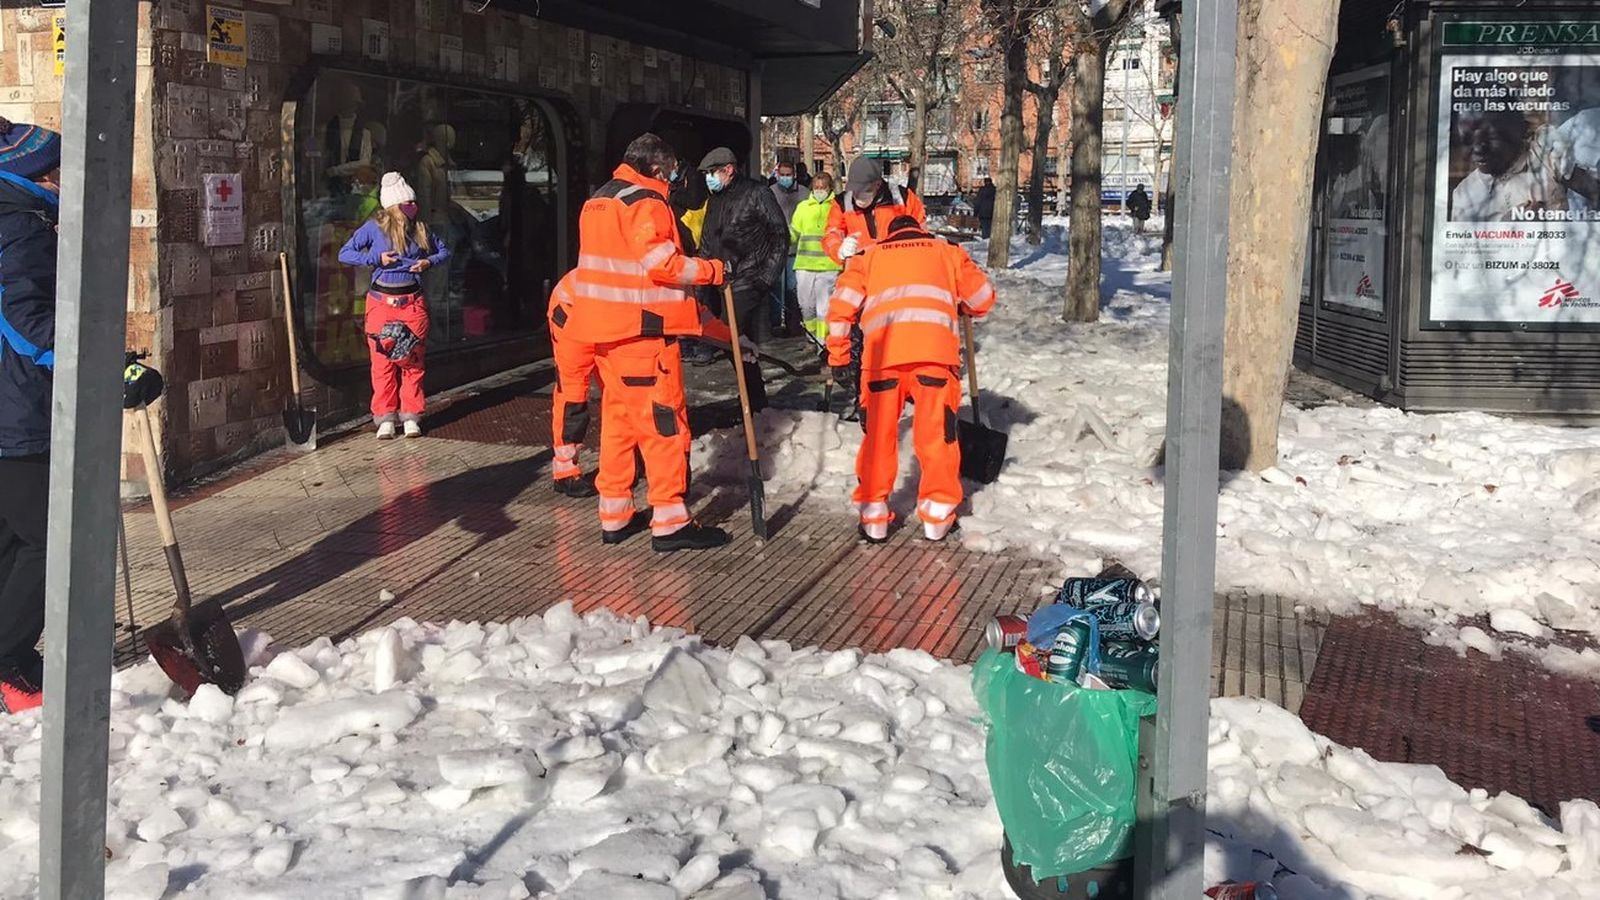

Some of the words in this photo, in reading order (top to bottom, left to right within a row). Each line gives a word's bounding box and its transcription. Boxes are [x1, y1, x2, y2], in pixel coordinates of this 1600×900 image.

[1477, 25, 1600, 43] PRENSA
[1453, 69, 1483, 84] Hay
[1485, 69, 1518, 84] algo
[1519, 71, 1549, 84] que
[1453, 85, 1473, 98] da
[1475, 84, 1507, 98] más
[1509, 84, 1556, 98] miedo
[1453, 101, 1482, 114] que
[1484, 99, 1506, 111] las
[1507, 101, 1570, 111] vacunas
[1511, 207, 1535, 221] No
[1445, 230, 1473, 239] Envía
[1474, 230, 1525, 239] VACUNAR
[1526, 230, 1536, 239] al
[1537, 231, 1567, 239] 28033
[882, 242, 933, 250] DEPORTES
[1445, 261, 1453, 270] O
[1485, 261, 1519, 270] BIZUM
[1520, 261, 1530, 270] al
[1531, 261, 1560, 270] 38021
